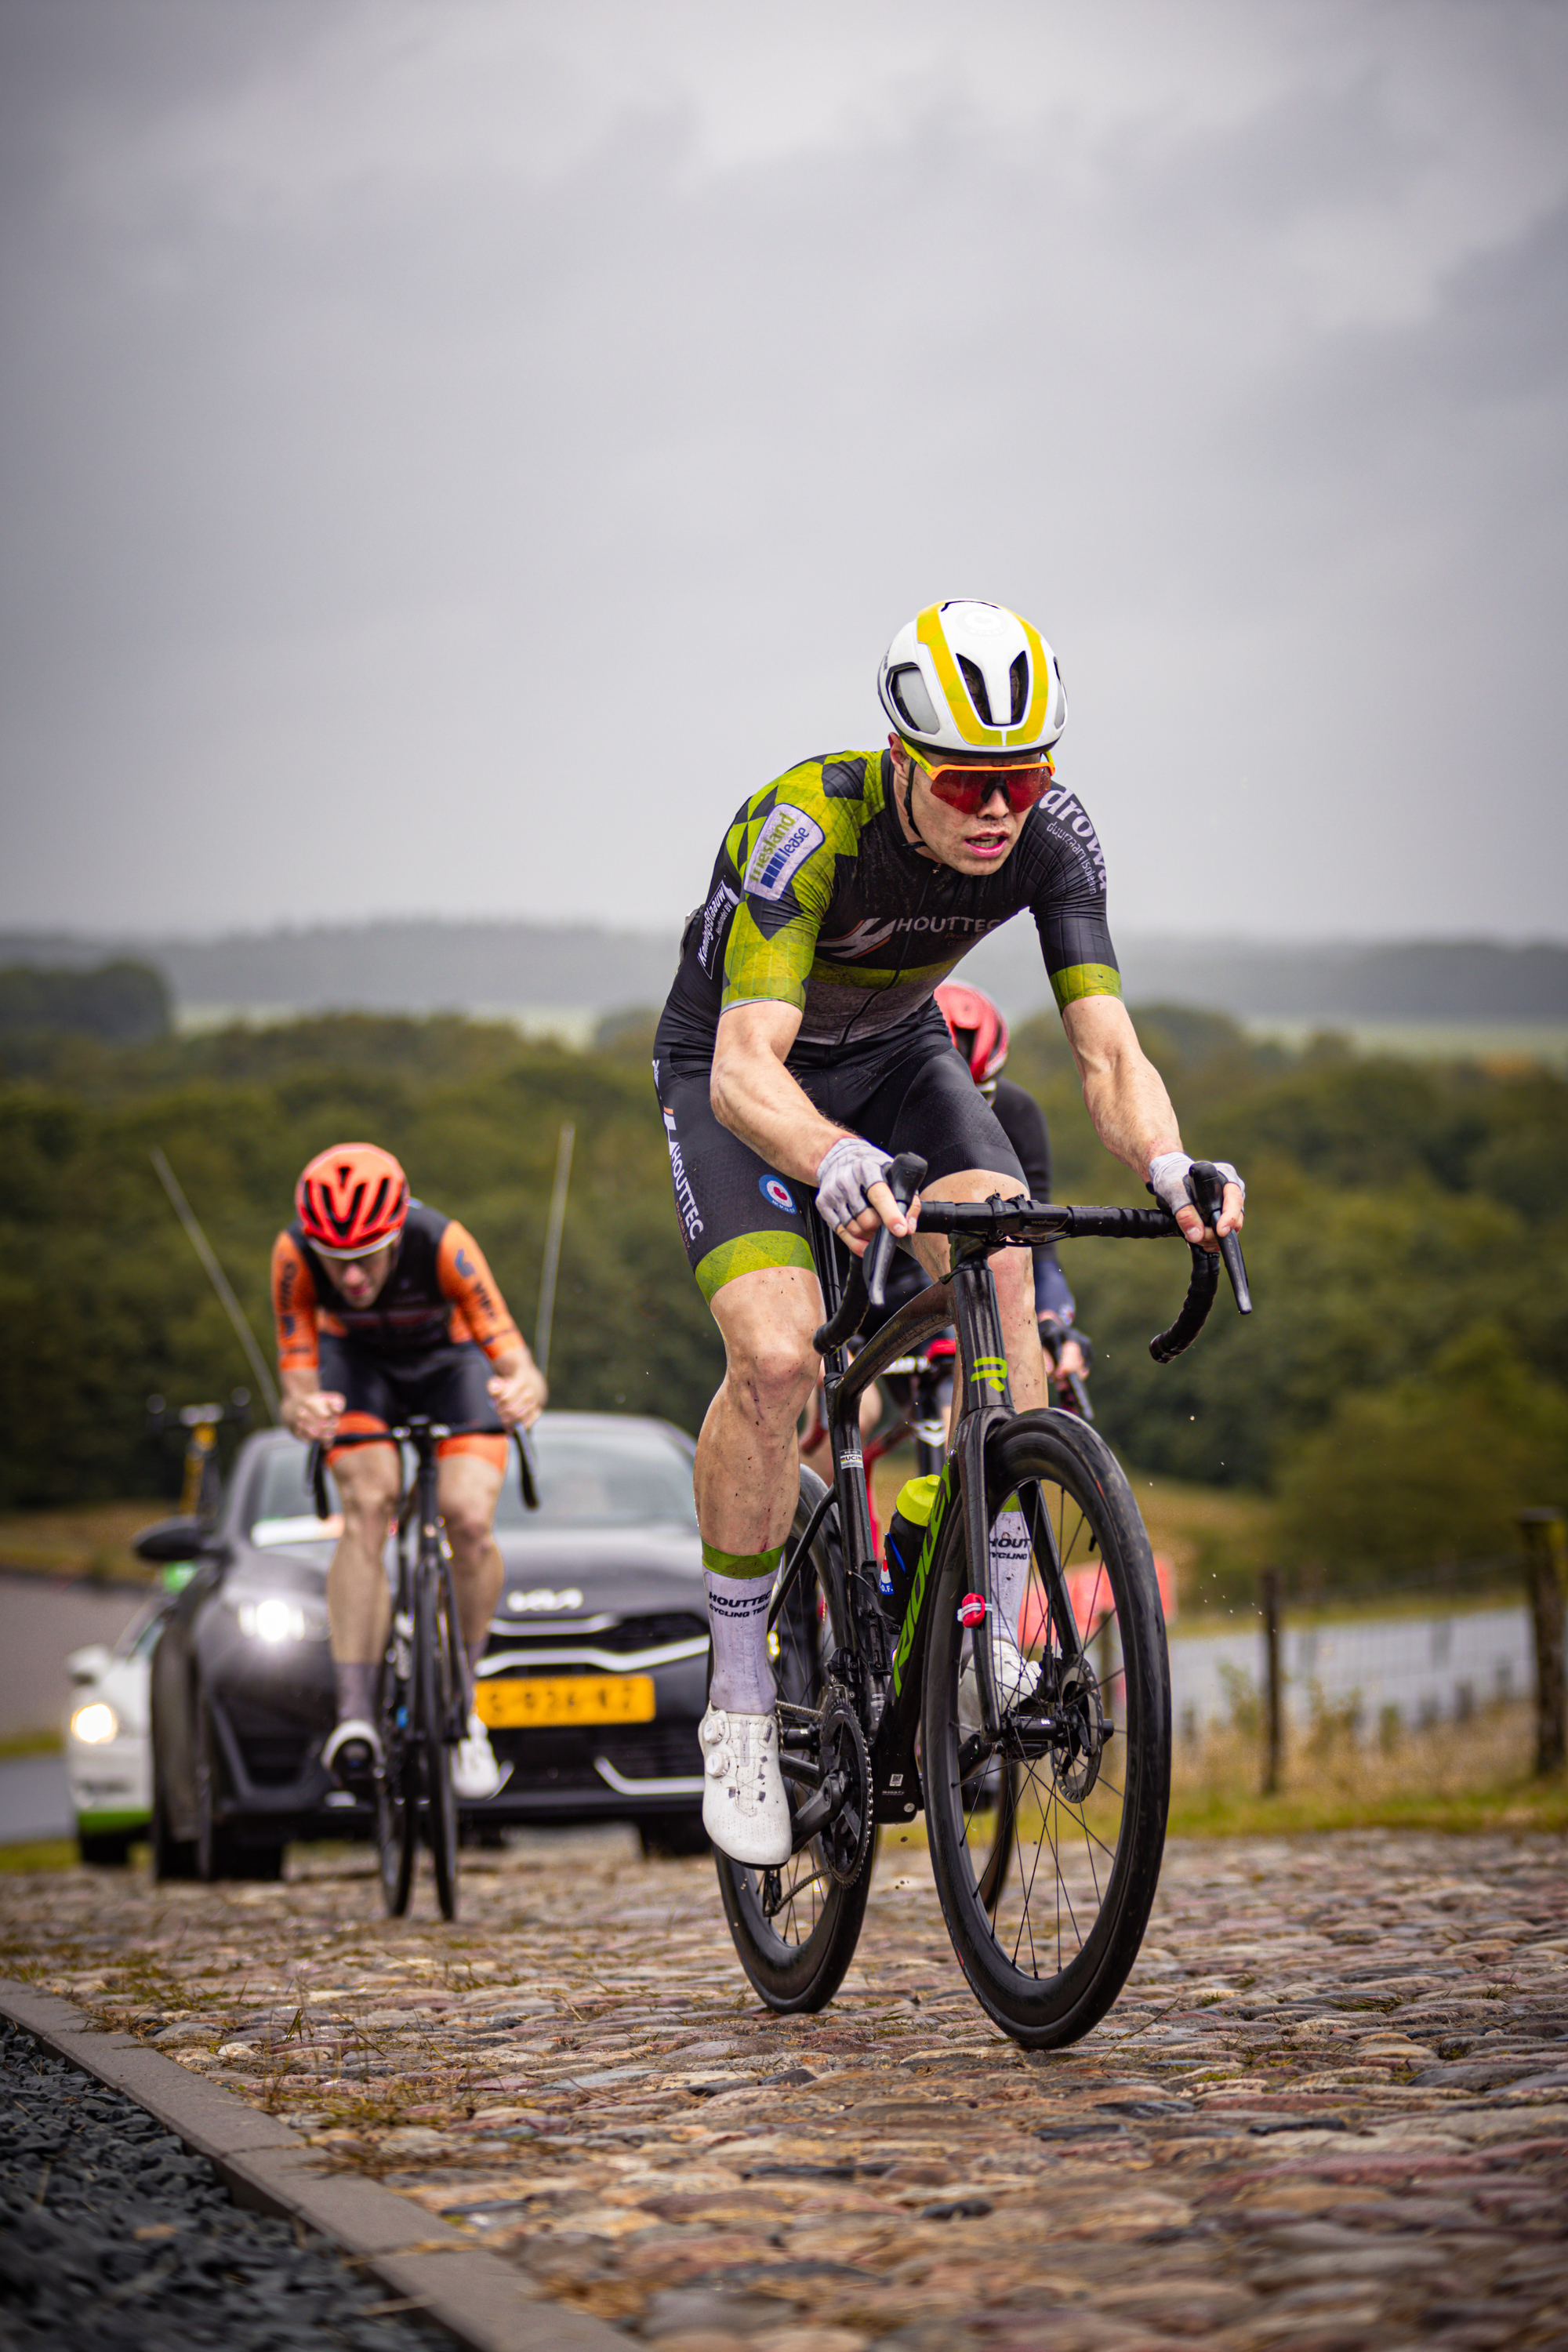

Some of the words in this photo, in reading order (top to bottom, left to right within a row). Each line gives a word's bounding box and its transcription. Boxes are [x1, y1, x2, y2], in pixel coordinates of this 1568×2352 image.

[749, 812, 796, 883] friesland
[779, 827, 810, 857] lease
[1047, 822, 1087, 861] duurzaam
[698, 886, 727, 967] KoningsBlaauw
[896, 916, 1001, 933] HOUTTEC
[672, 1145, 704, 1240] HOUTTEC
[709, 1589, 771, 1608] HOUTTEC
[893, 1464, 951, 1697] RIDLEY
[709, 1603, 750, 1618] CYCLING
